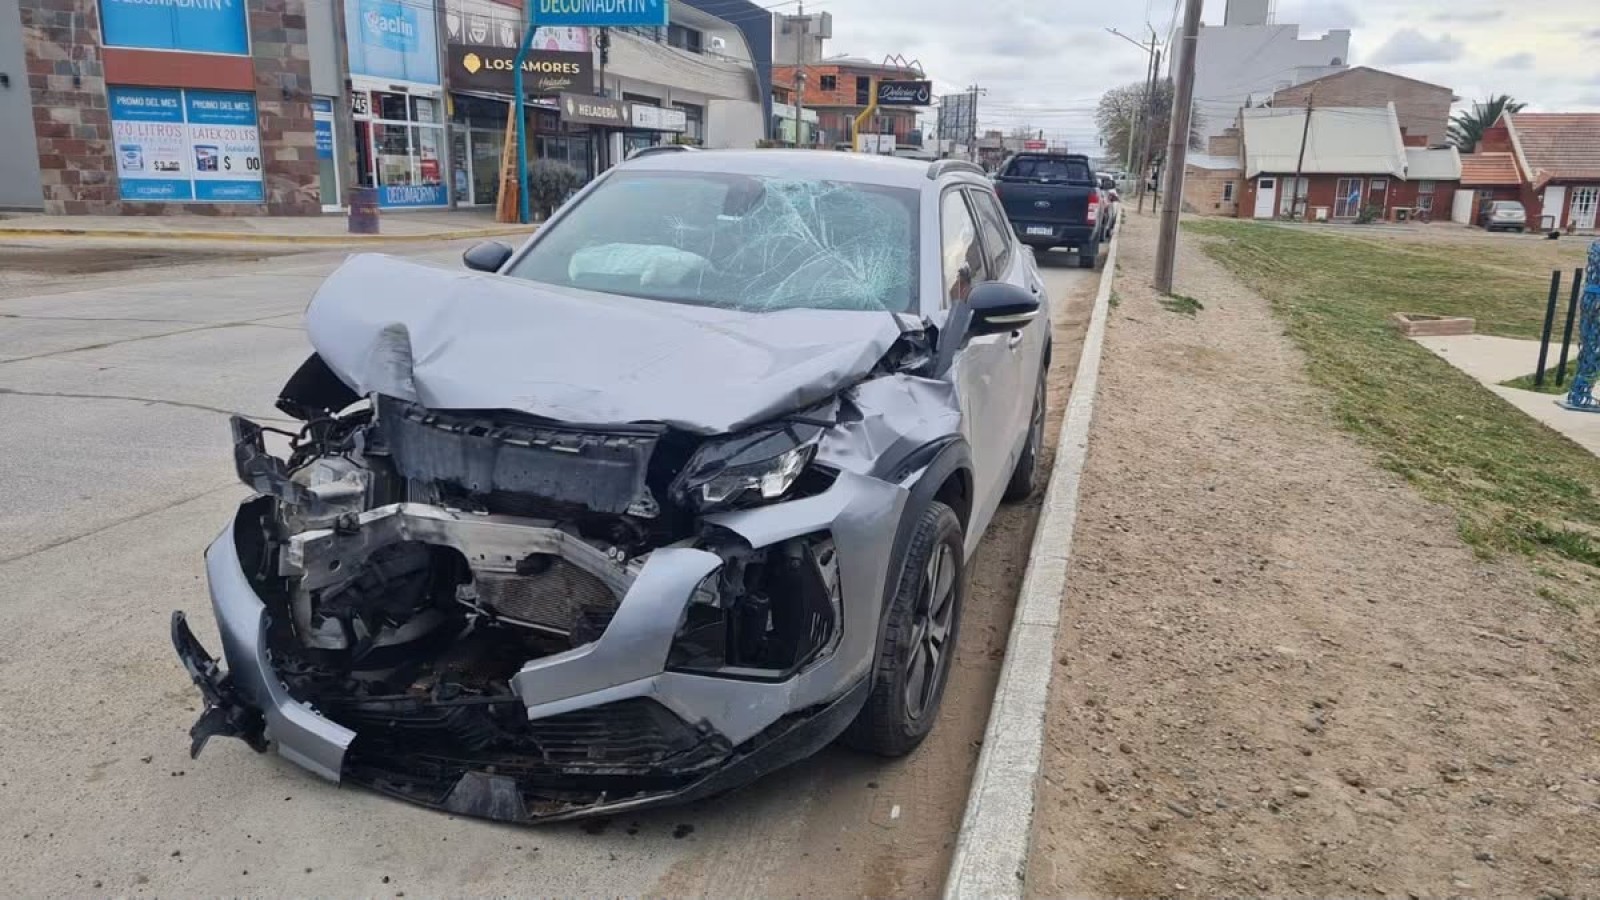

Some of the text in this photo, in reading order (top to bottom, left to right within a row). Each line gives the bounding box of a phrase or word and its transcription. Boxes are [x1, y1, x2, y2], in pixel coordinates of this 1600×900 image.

[484, 58, 581, 75] LOS AMORES
[116, 95, 178, 108] PROMO DEL MES
[192, 100, 250, 112] PROMO DEL MES
[118, 122, 182, 138] 20 LITROS
[192, 127, 256, 141] LATEX 20 LTS
